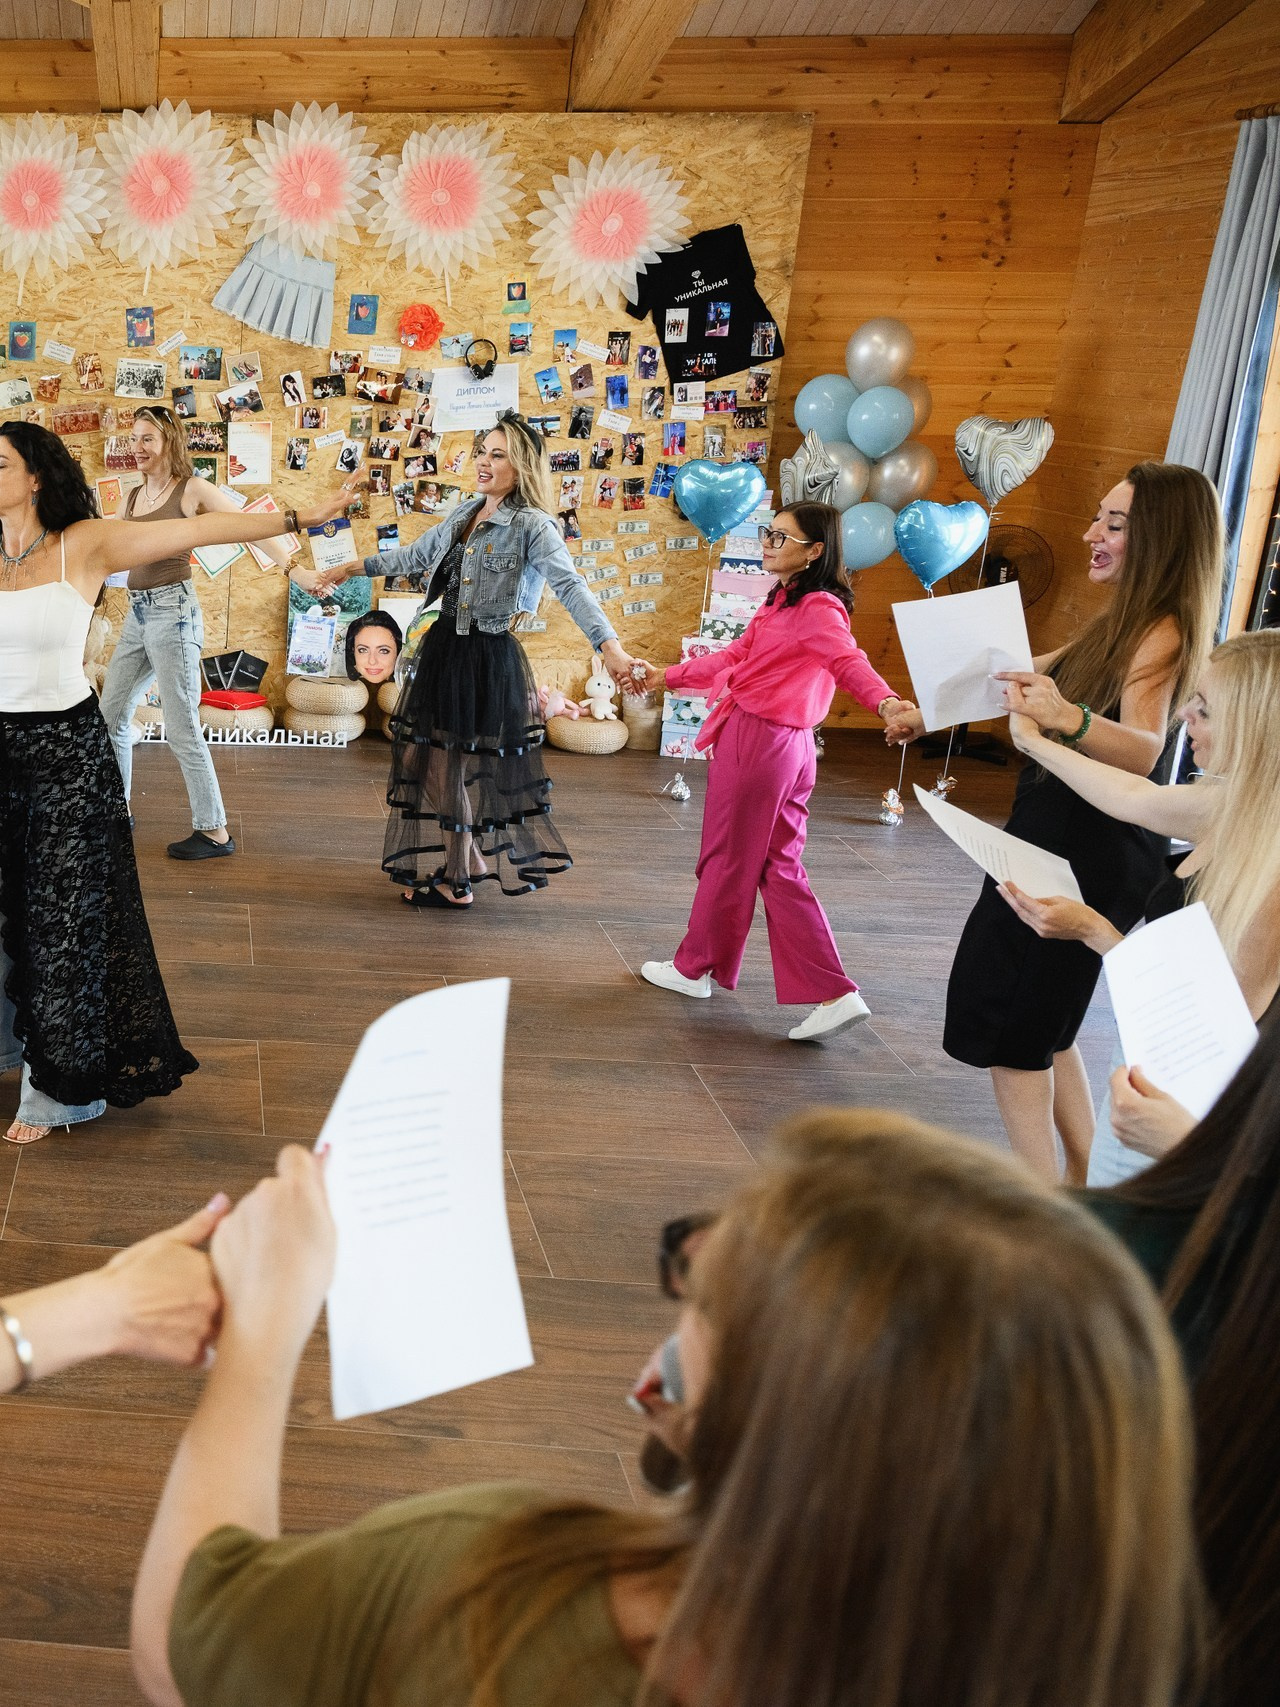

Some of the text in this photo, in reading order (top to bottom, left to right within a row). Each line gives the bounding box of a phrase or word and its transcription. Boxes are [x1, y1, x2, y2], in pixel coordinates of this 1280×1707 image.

[693, 278, 705, 288] ТЫ
[674, 278, 728, 303] УНИКАЛЬНАЯ
[455, 386, 496, 397] ДИПЛОМ
